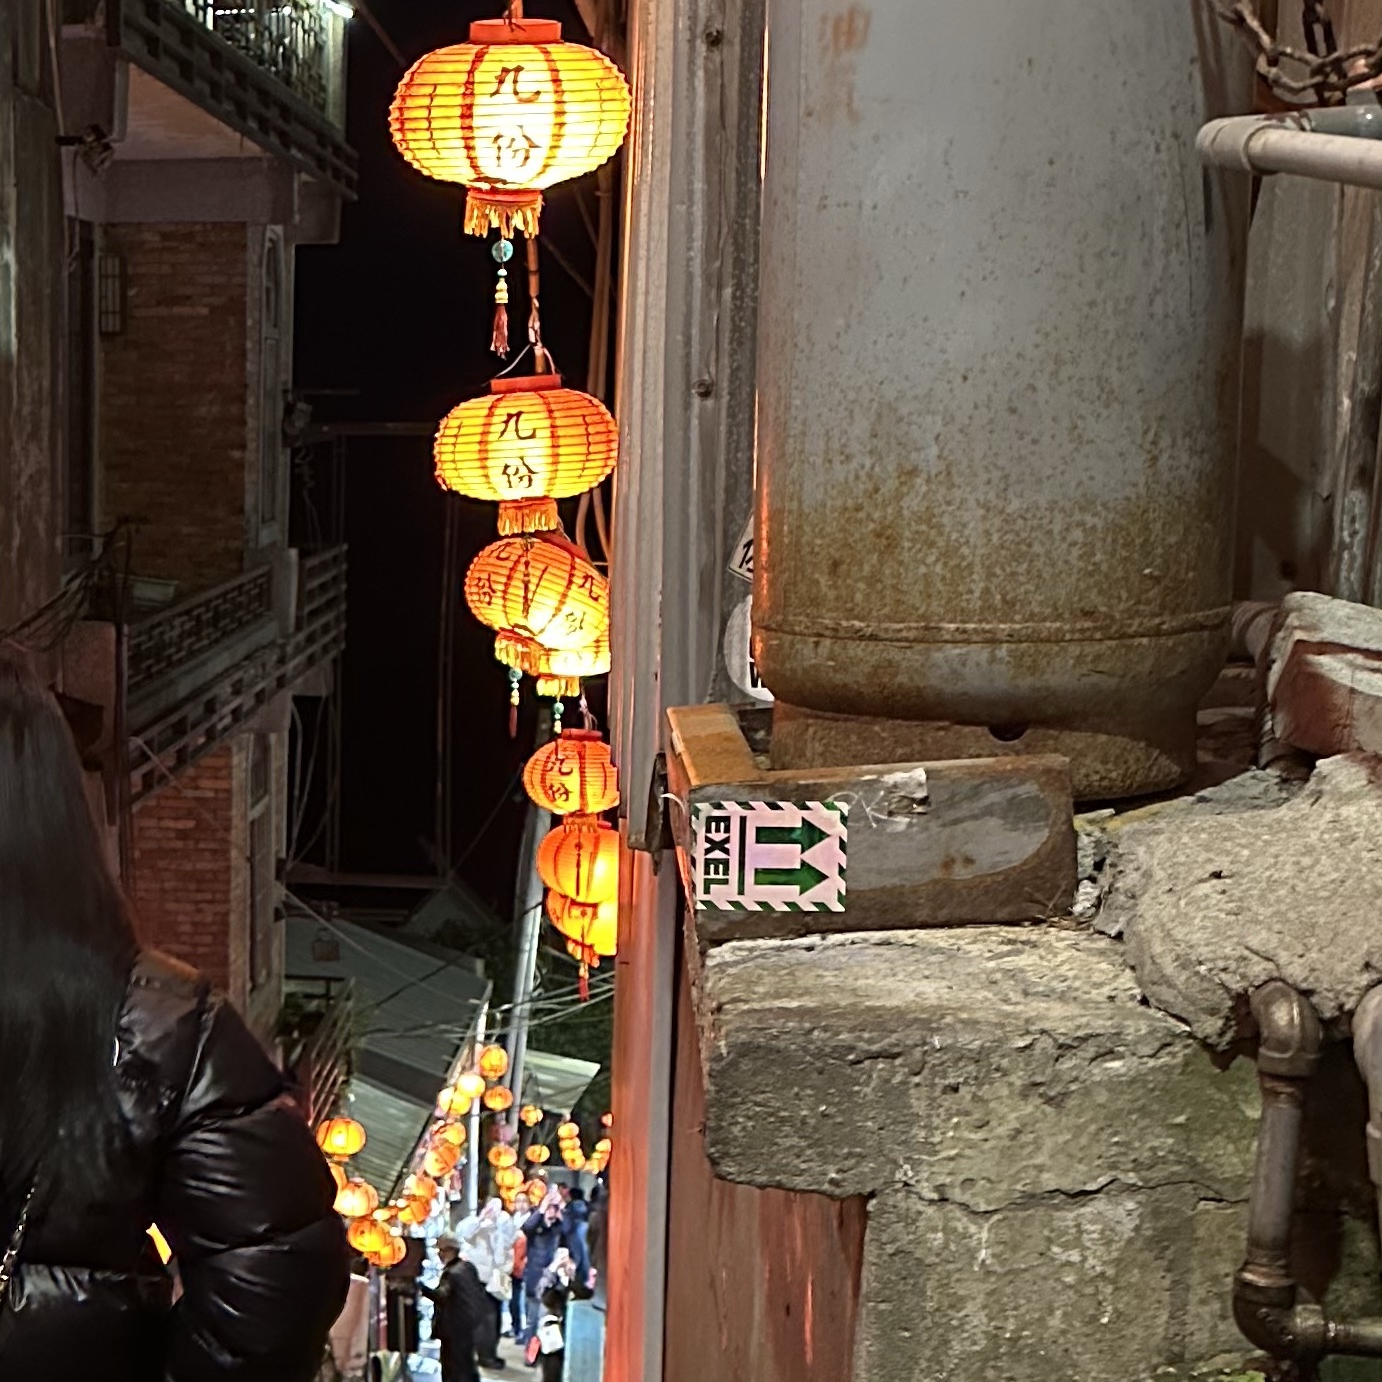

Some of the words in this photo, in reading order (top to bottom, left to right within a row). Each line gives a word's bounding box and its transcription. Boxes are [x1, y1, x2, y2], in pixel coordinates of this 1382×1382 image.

[490, 64, 542, 168] 九份
[498, 410, 539, 488] 九份
[703, 815, 731, 895] EXEL
